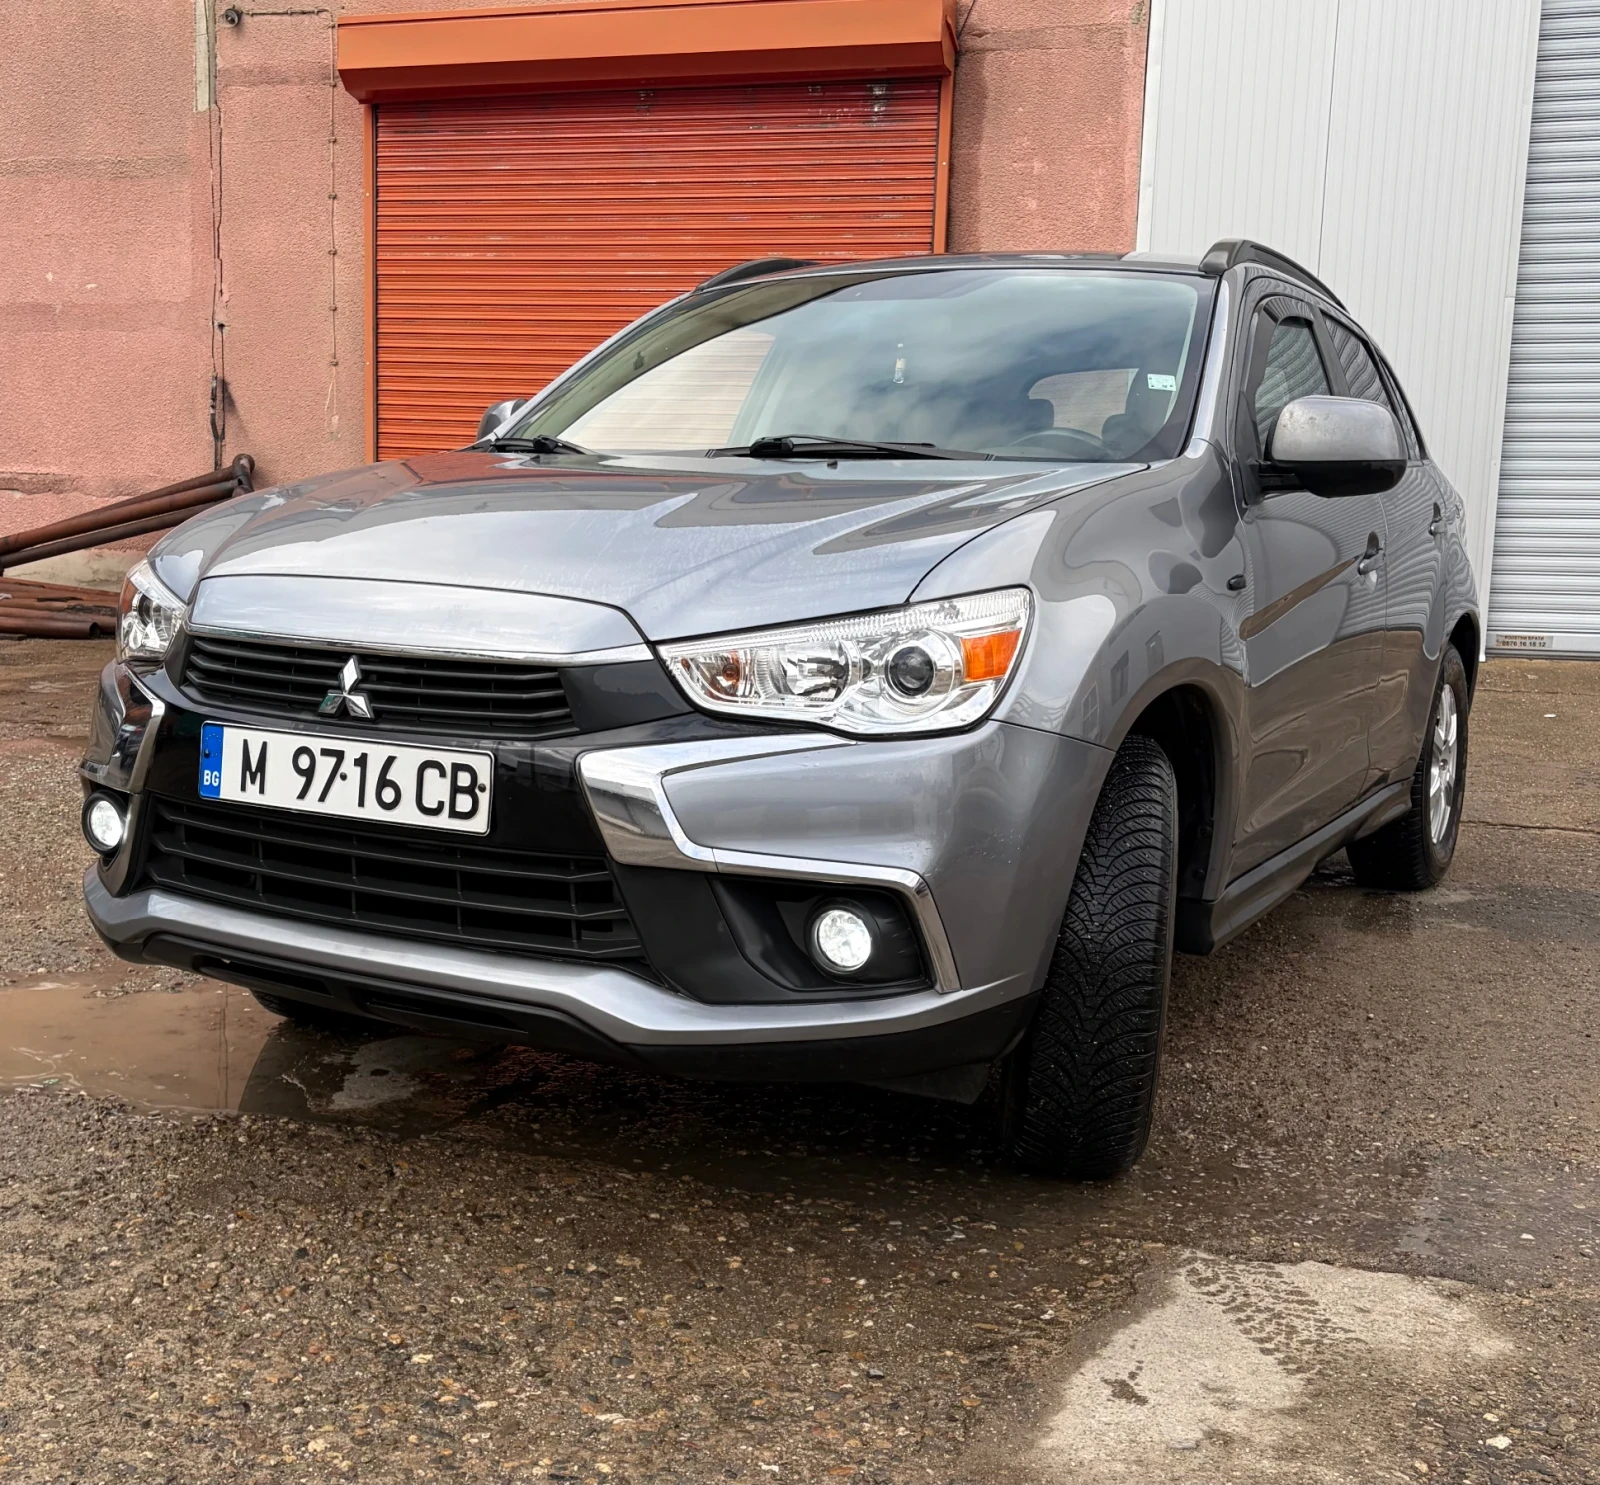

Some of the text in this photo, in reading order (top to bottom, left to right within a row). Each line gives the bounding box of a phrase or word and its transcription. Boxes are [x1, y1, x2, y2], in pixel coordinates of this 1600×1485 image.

[203, 769, 219, 787] BG
[240, 739, 268, 795] M
[415, 759, 479, 820] CB
